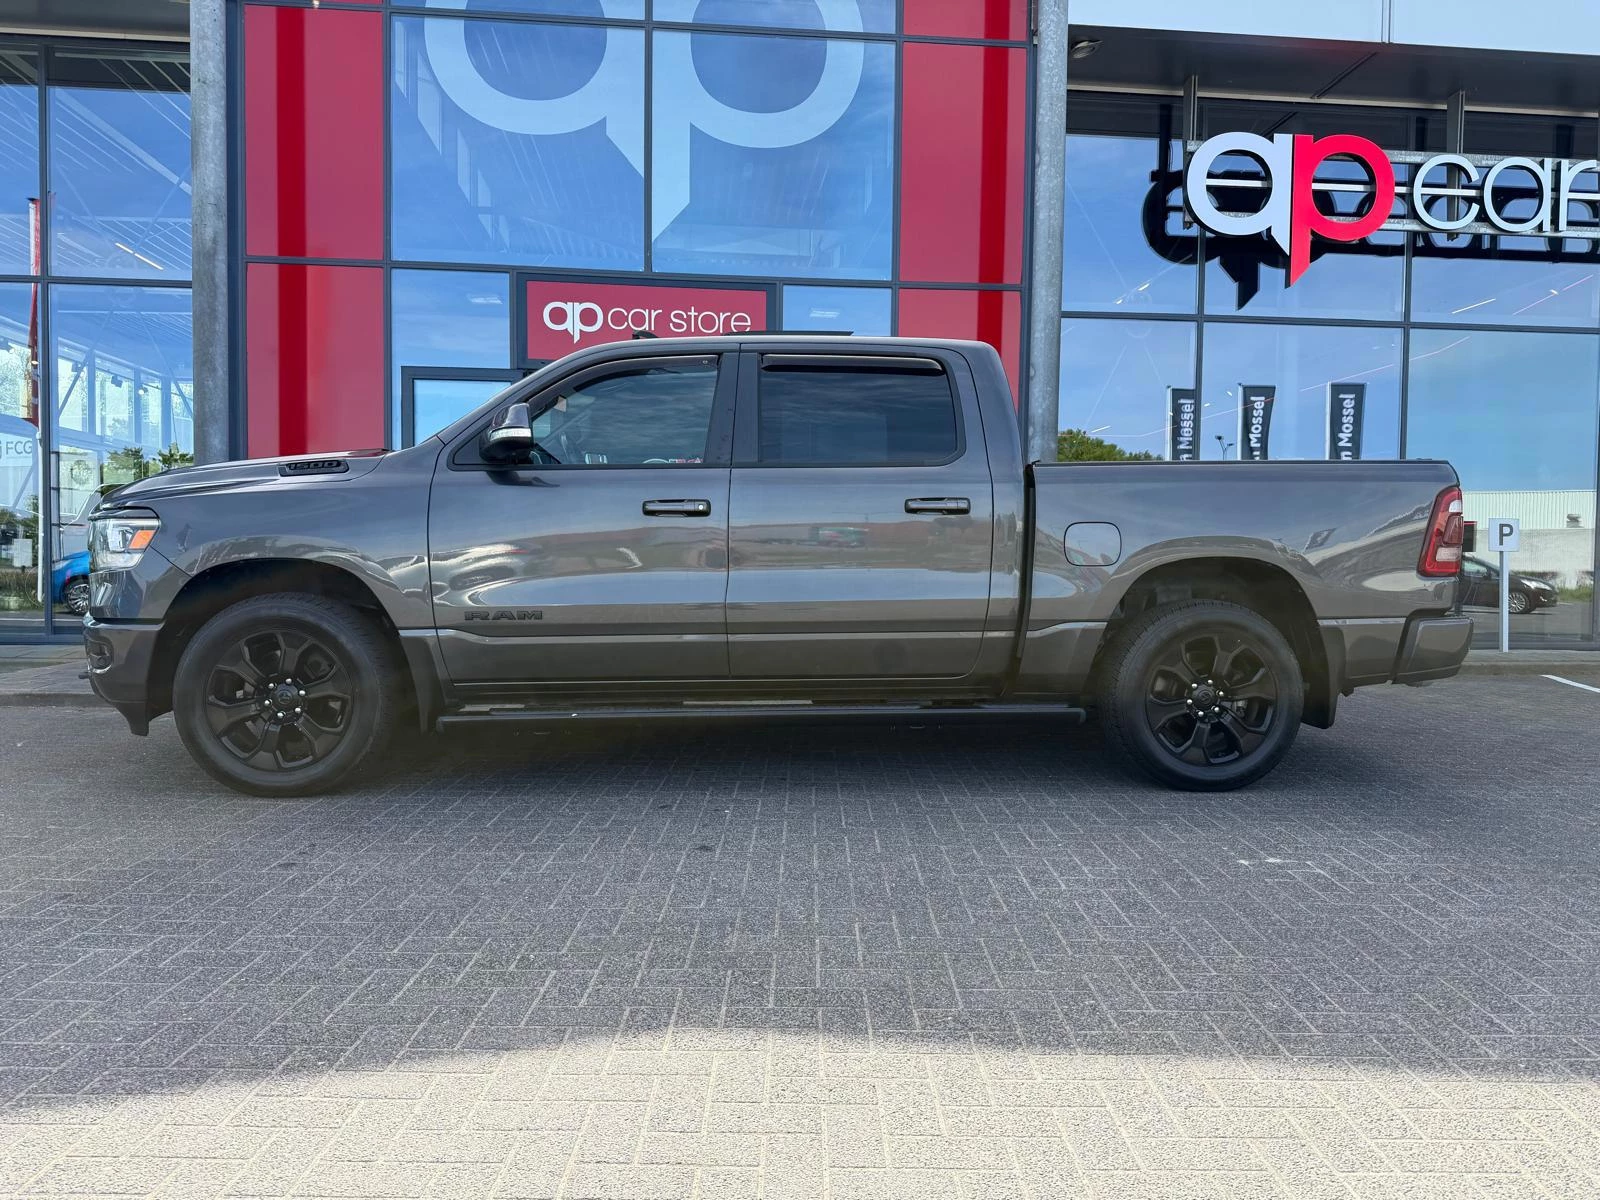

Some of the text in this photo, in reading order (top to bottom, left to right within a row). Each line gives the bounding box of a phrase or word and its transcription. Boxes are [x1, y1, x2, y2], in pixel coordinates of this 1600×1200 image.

[1187, 132, 1598, 286] ap car
[543, 301, 752, 344] ap car store
[1177, 398, 1195, 449] Mossel
[1249, 396, 1266, 448] Mossel
[1338, 393, 1356, 447] Mossel
[289, 460, 338, 470] 1500
[1498, 523, 1514, 546] P
[464, 610, 543, 621] RAM
